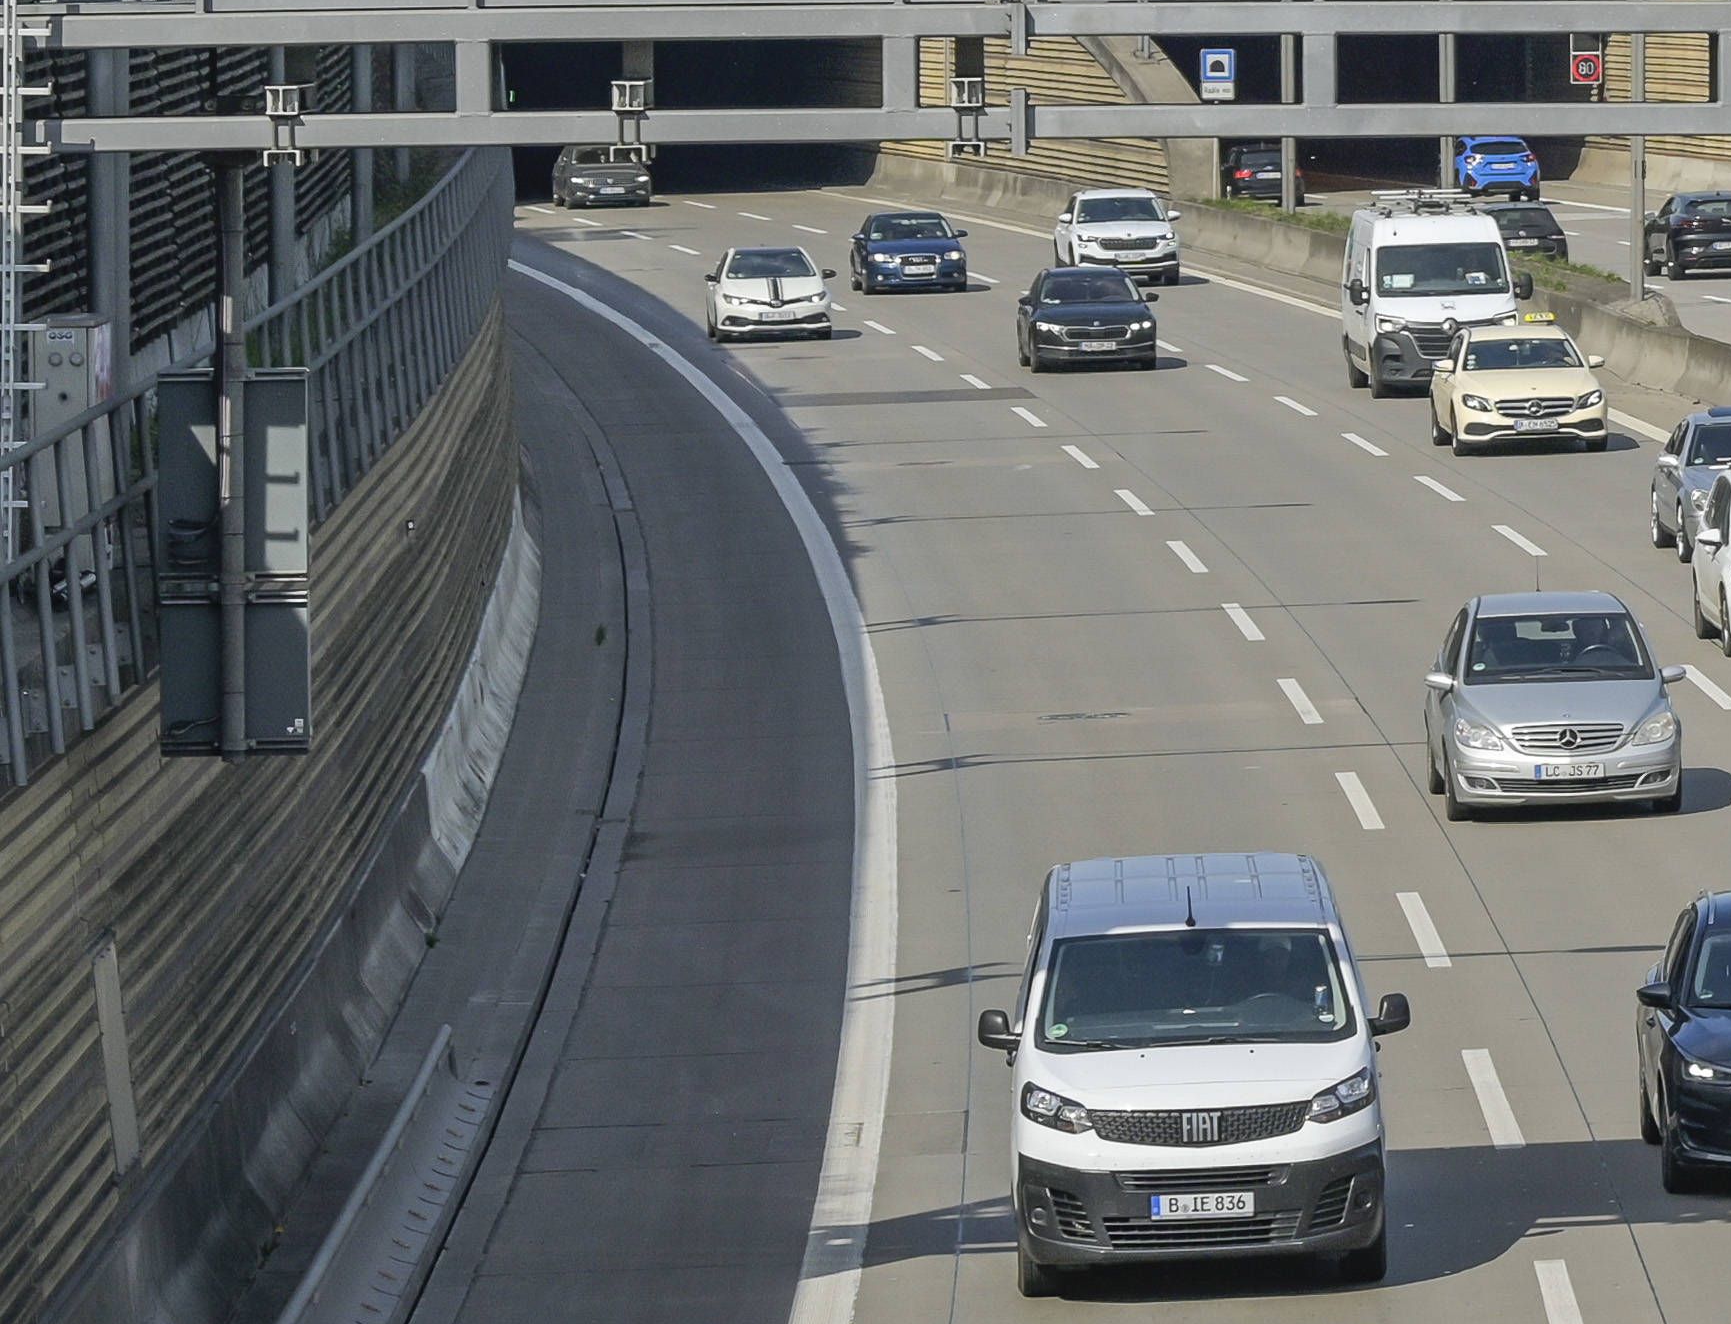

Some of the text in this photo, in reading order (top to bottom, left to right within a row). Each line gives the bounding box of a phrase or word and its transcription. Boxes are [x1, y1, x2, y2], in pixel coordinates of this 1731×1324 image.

[1545, 764, 1600, 777] LC JS 77
[1182, 1112, 1222, 1143] FIAT
[1169, 1194, 1247, 1213] B IE 836
